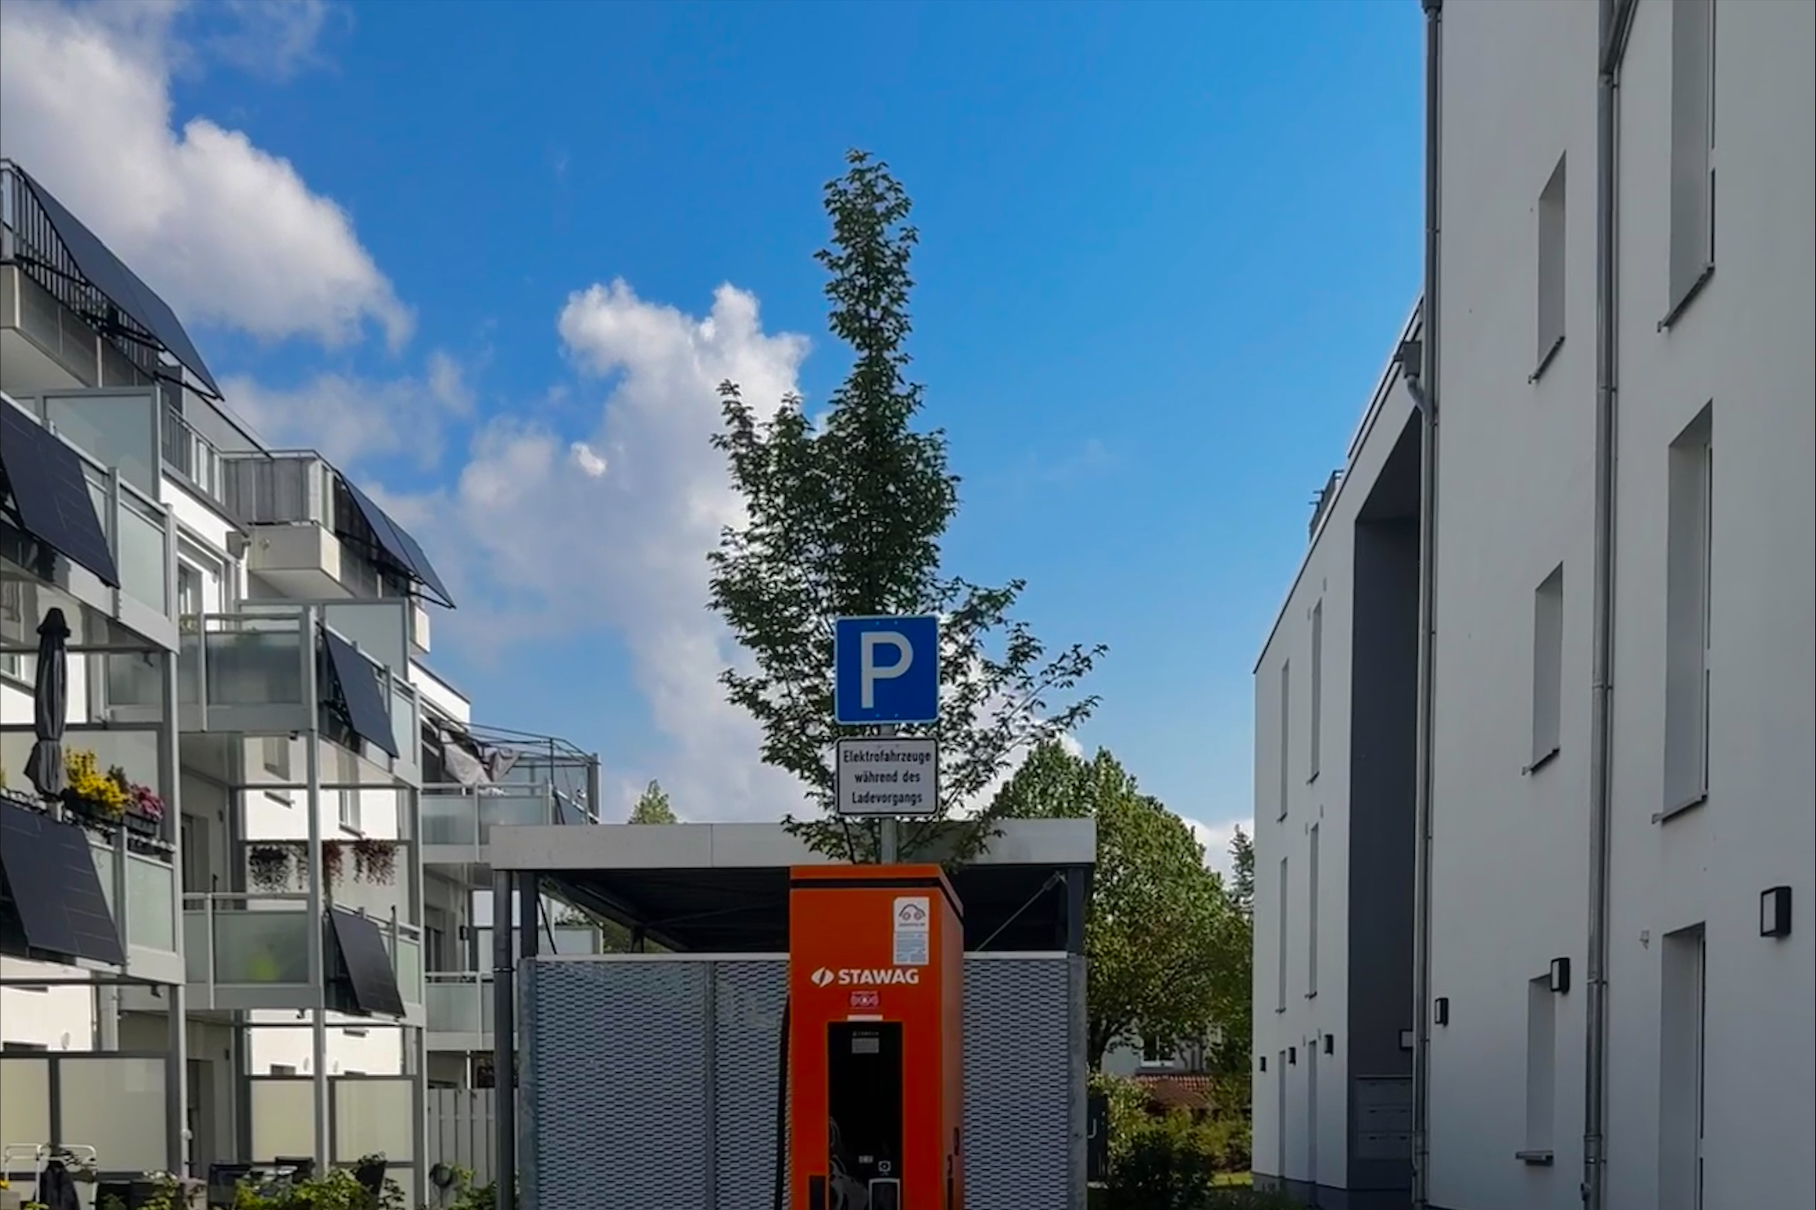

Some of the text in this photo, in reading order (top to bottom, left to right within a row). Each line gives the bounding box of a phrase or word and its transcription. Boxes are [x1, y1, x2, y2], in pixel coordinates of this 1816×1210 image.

[860, 631, 914, 709] P
[843, 750, 932, 765] Elektrofahrzeuge
[854, 770, 921, 783] während des
[852, 791, 923, 807] Ladevorgangs
[837, 968, 920, 985] STAWAG
